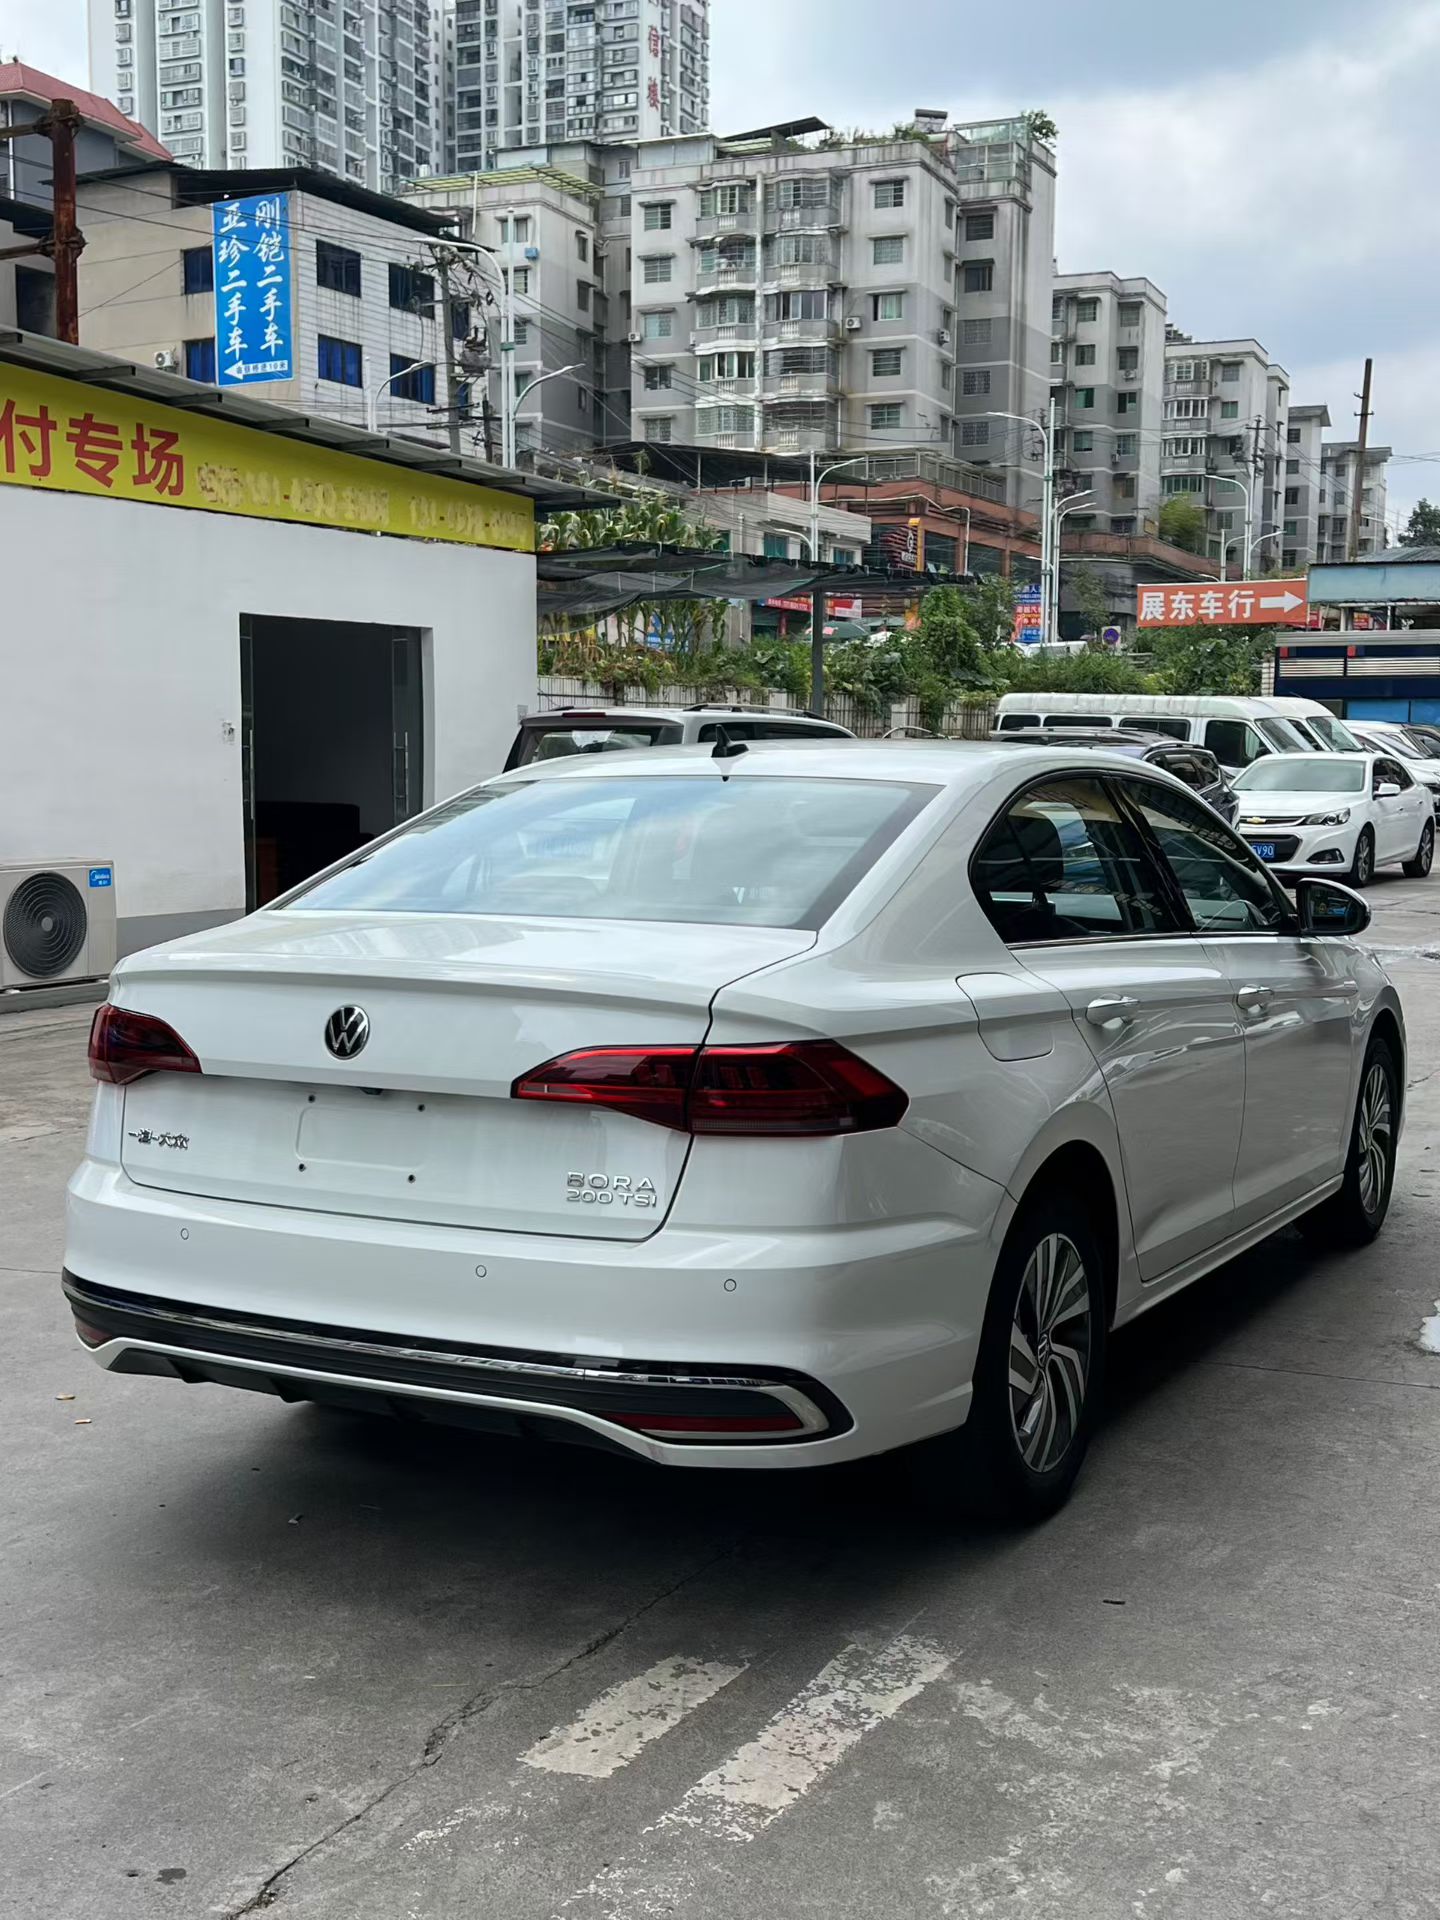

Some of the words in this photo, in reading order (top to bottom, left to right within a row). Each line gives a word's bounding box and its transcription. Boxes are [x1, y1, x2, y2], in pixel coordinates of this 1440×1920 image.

[217, 202, 250, 361] 亚珍二手车
[0, 398, 184, 496] 付专场
[1140, 590, 1255, 622] 展东车行
[567, 1171, 655, 1192] BORA
[567, 1189, 613, 1204] 200
[618, 1192, 656, 1207] TSI
